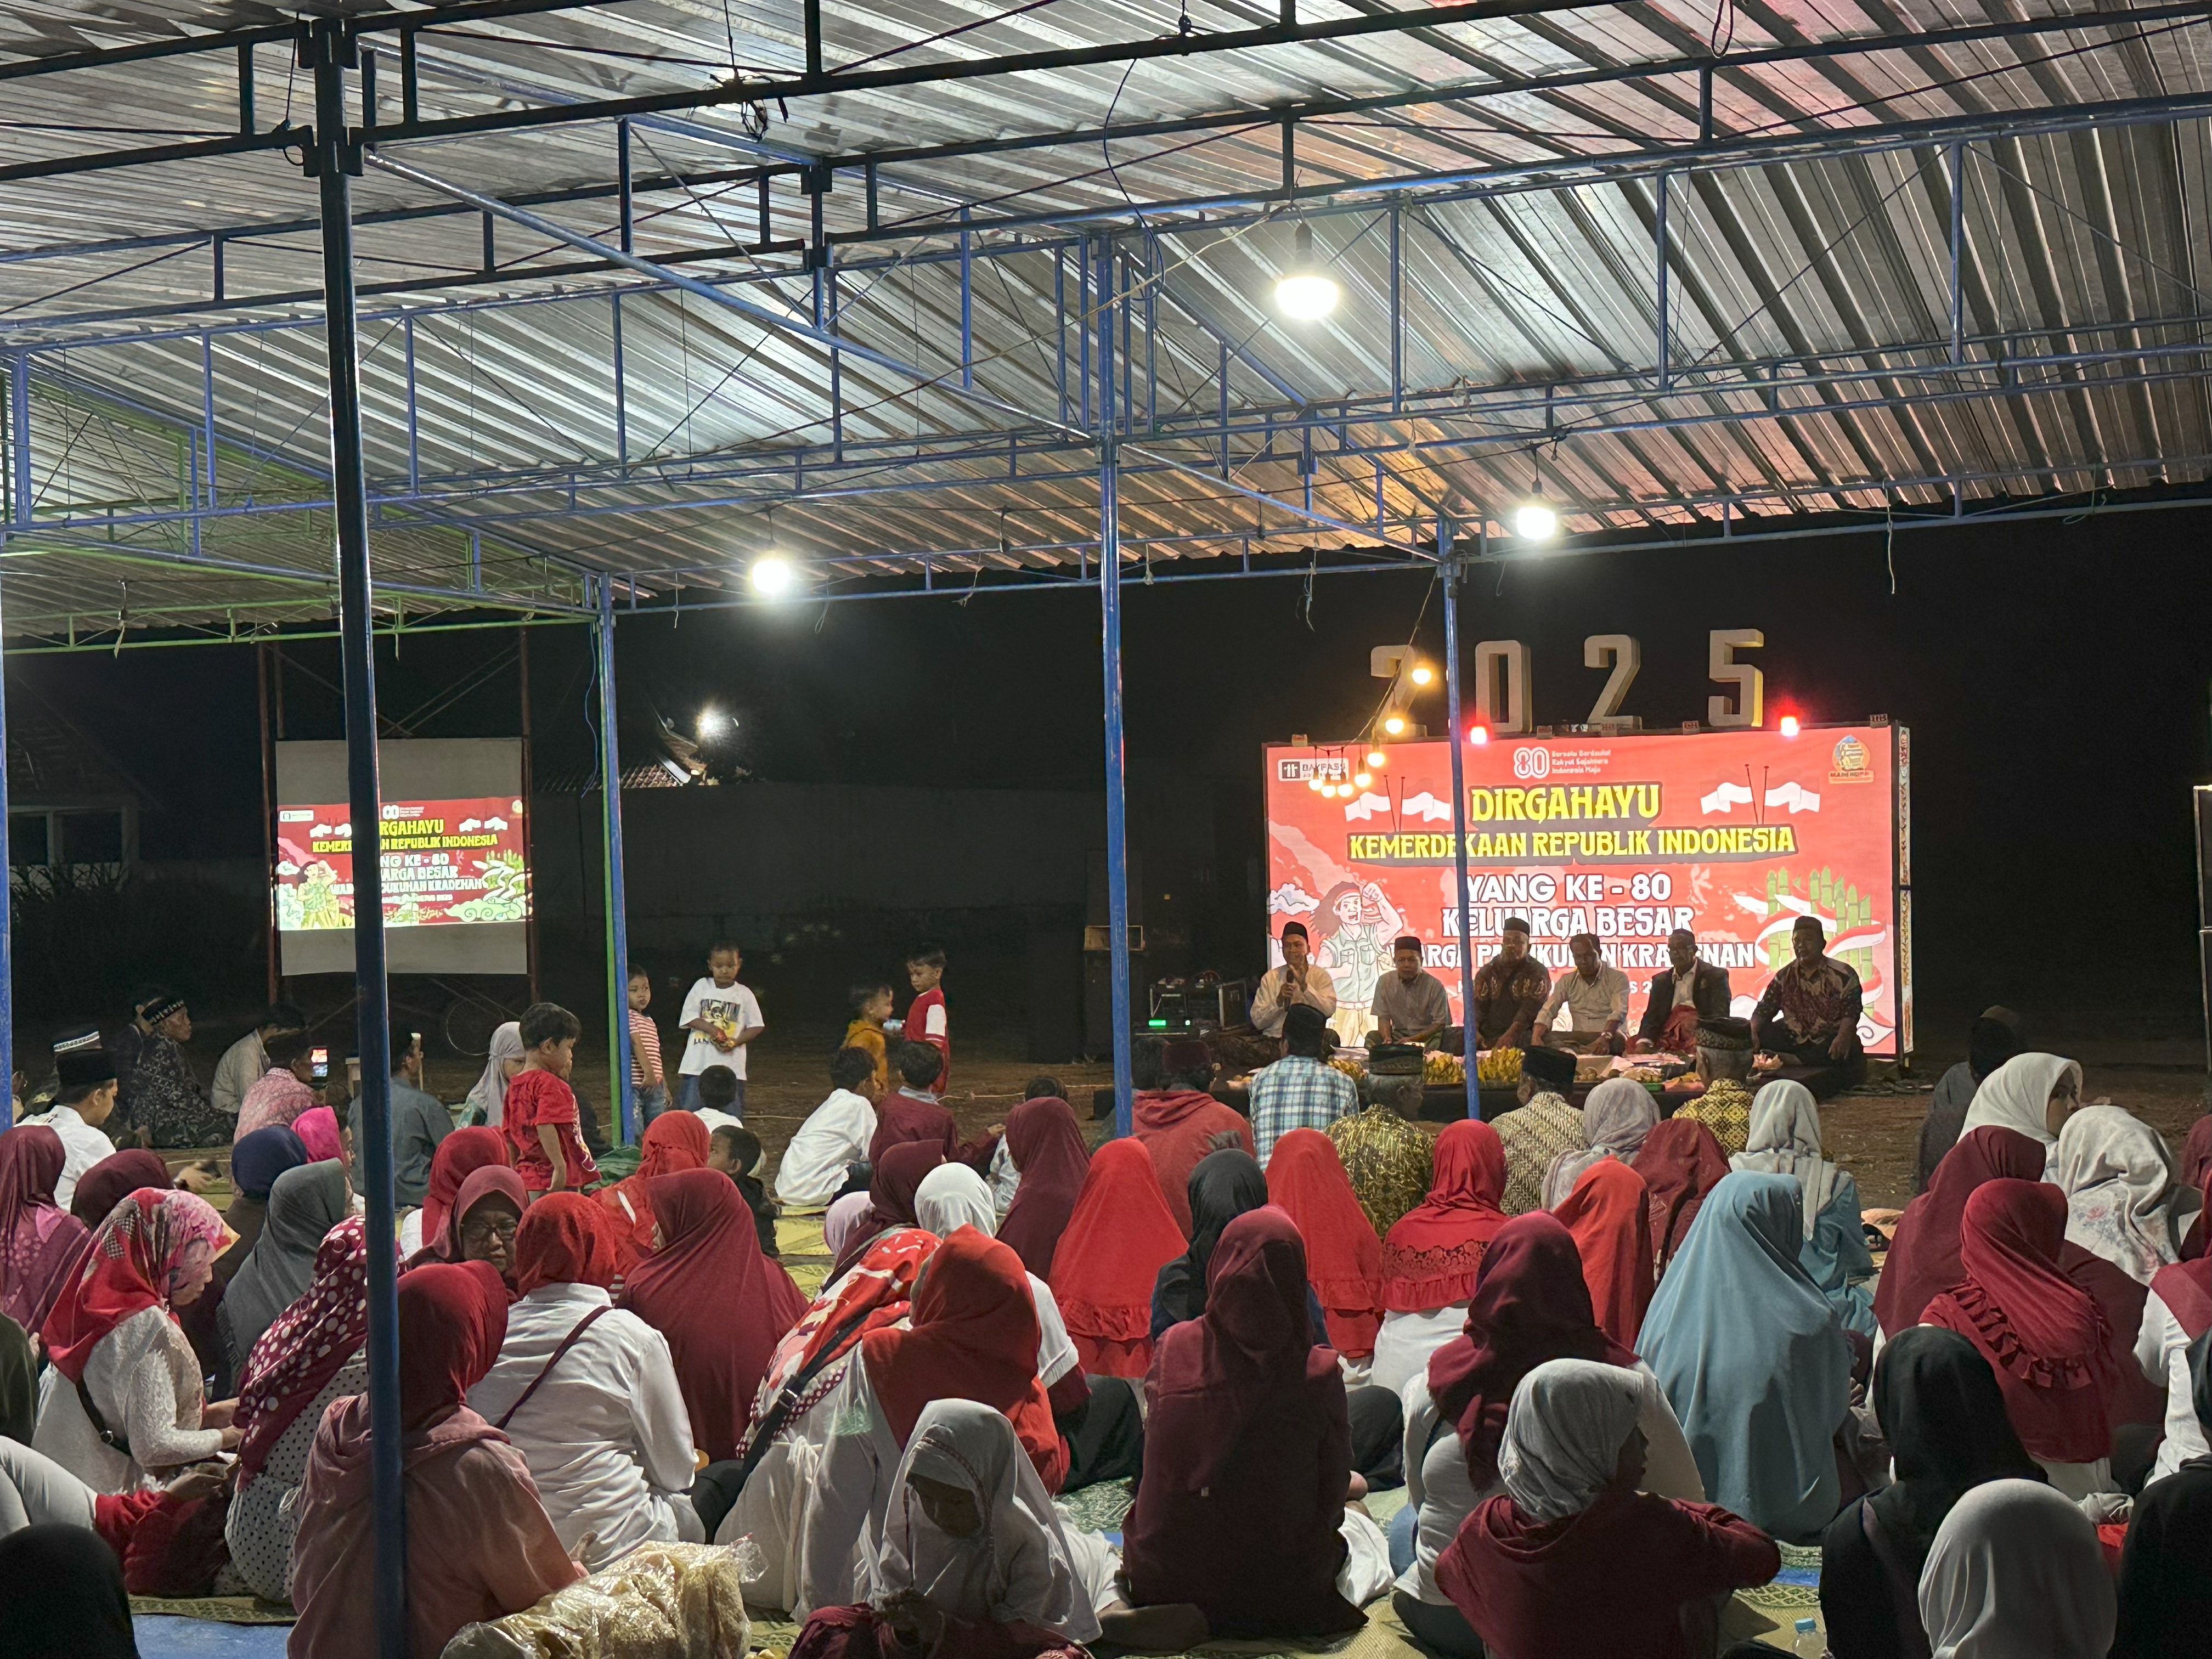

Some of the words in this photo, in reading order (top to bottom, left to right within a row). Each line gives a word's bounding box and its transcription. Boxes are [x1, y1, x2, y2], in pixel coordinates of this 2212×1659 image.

[1370, 629, 1764, 738] 2025
[1513, 746, 1550, 780] 80
[1471, 785, 1661, 824] DIRGAHAYU
[379, 819, 444, 836] RGAHAYU
[1533, 830, 1652, 857] REPUBLIK
[1658, 826, 1796, 854] INDONESIA
[391, 837, 441, 850] REPUBLIK
[417, 866, 459, 879] BESAR
[1467, 874, 1556, 902] YANG
[1566, 875, 1603, 900] KE
[1632, 874, 1671, 900] 80
[1597, 907, 1694, 936] BESAR
[1622, 943, 1754, 968] KRANAN
